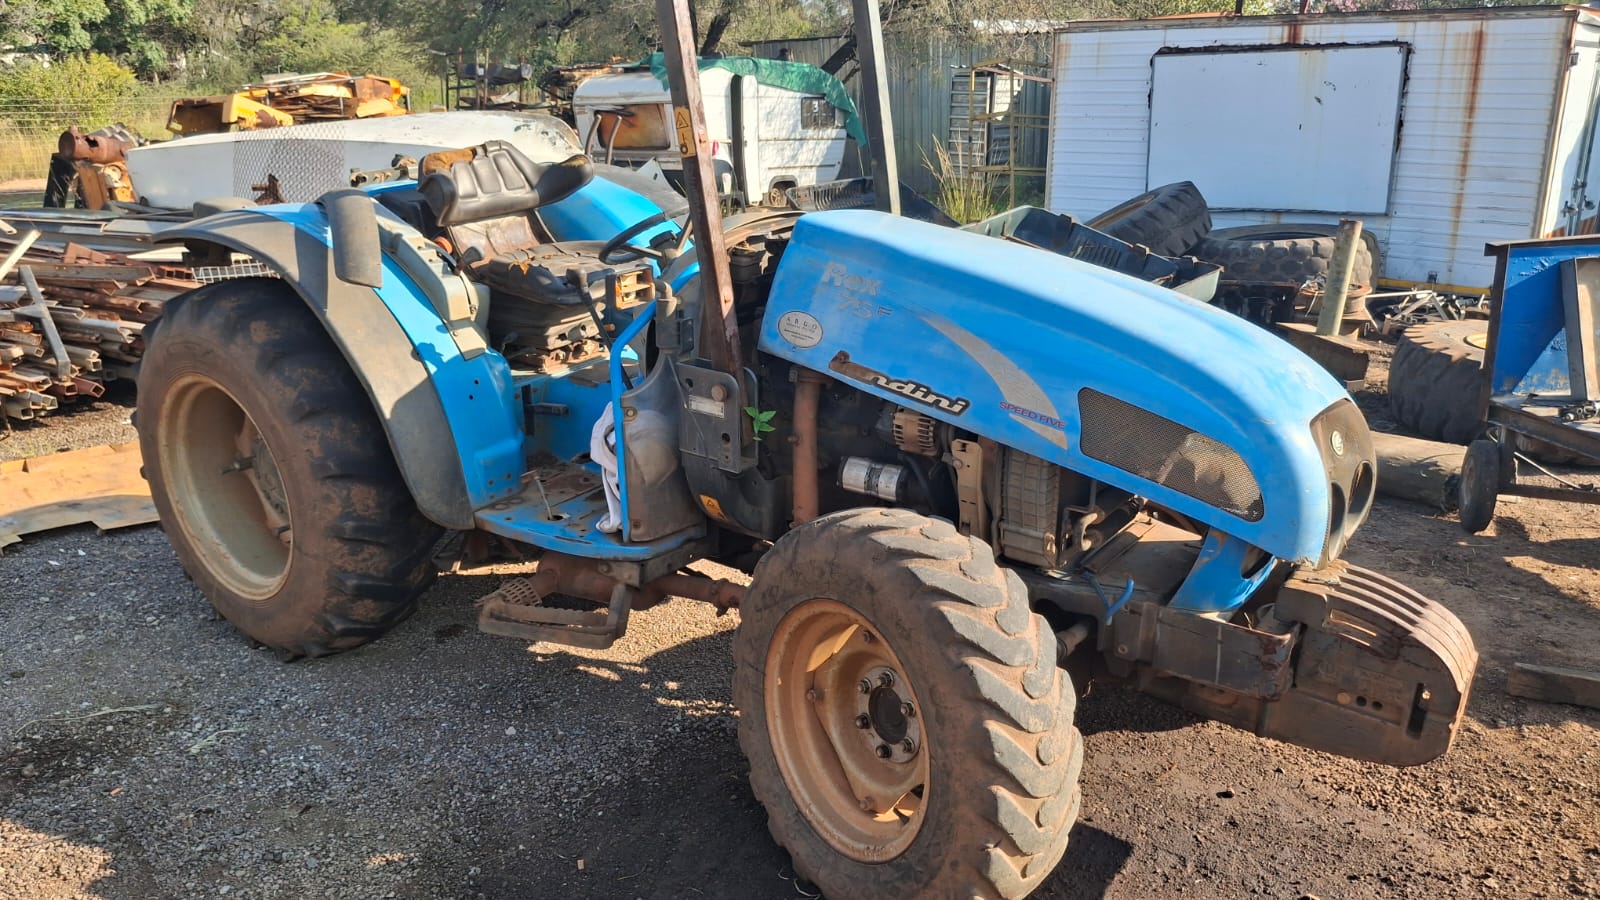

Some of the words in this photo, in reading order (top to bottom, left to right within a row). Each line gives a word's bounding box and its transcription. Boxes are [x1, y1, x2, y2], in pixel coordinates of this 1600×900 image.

[821, 261, 883, 296] Rex
[1000, 401, 1037, 419] SPEED
[1040, 415, 1065, 429] FIVE
